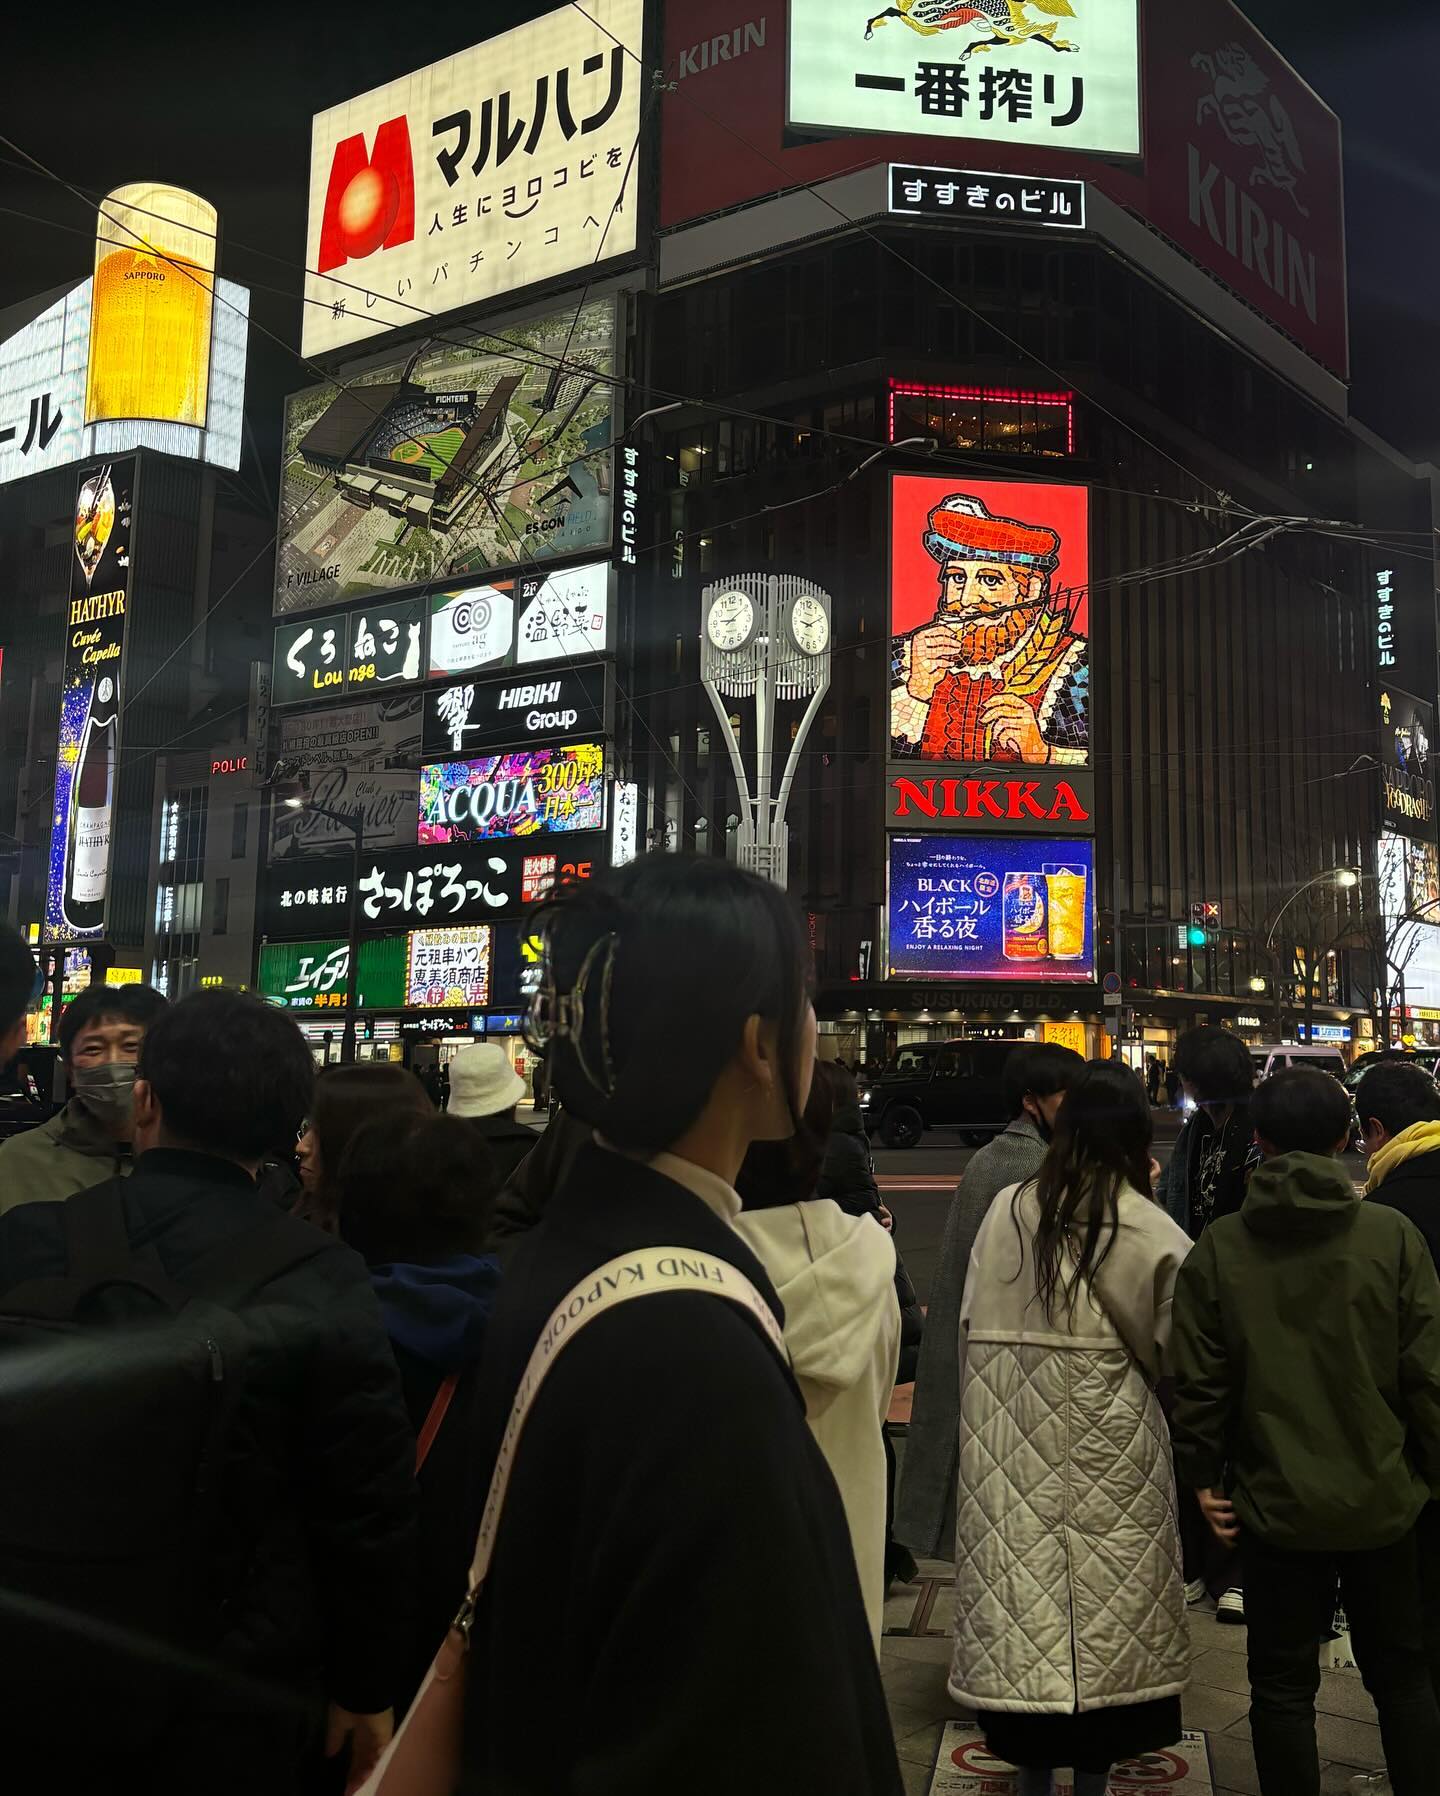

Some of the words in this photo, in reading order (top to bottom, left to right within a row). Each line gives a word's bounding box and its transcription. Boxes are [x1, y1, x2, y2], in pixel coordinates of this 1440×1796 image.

[678, 16, 767, 80] KIRIN
[854, 61, 1084, 127] 一番搾り
[431, 44, 624, 188] マルハン
[428, 147, 622, 236] 人生にヨロコビを
[902, 179, 1071, 216] すすきのビル
[1187, 142, 1317, 325] KIRIN
[123, 271, 166, 281] SAPPORO
[331, 215, 600, 321] 新しいパチンコへ
[435, 394, 469, 404] FIGHTERS
[0, 392, 64, 456] ール
[623, 447, 638, 565] すすきのビル
[287, 571, 294, 588] F
[296, 564, 341, 585] VILLAGE
[522, 581, 538, 598] 2F
[70, 589, 126, 625] HATHYR
[1376, 569, 1396, 666] すすきのビル
[71, 627, 102, 648] Cuvée
[286, 617, 401, 679] くろねこ
[82, 643, 121, 665] Capella
[312, 663, 377, 689] Lounge
[498, 681, 562, 710] HIBIKI
[526, 708, 578, 730] Group
[537, 759, 597, 794] 300坪
[427, 776, 539, 825] ACQUA
[543, 794, 595, 822] 日本一
[890, 776, 1090, 822] NIKKA
[280, 885, 348, 908] 北の味紀行
[358, 856, 510, 919] さっぽろっこ
[918, 878, 972, 893] BLACK
[898, 896, 991, 916] ハイボール
[910, 916, 979, 940] 香る夜
[415, 946, 479, 967] 元祖串かつ
[413, 965, 486, 986] 恵美須商店
[431, 994, 441, 1004] 1F
[911, 991, 1015, 1009] SUSUKINO
[419, 1017, 455, 1032] さっぽろっこ
[656, 1257, 725, 1285] FIND
[542, 1262, 645, 1356] KAPOOR
